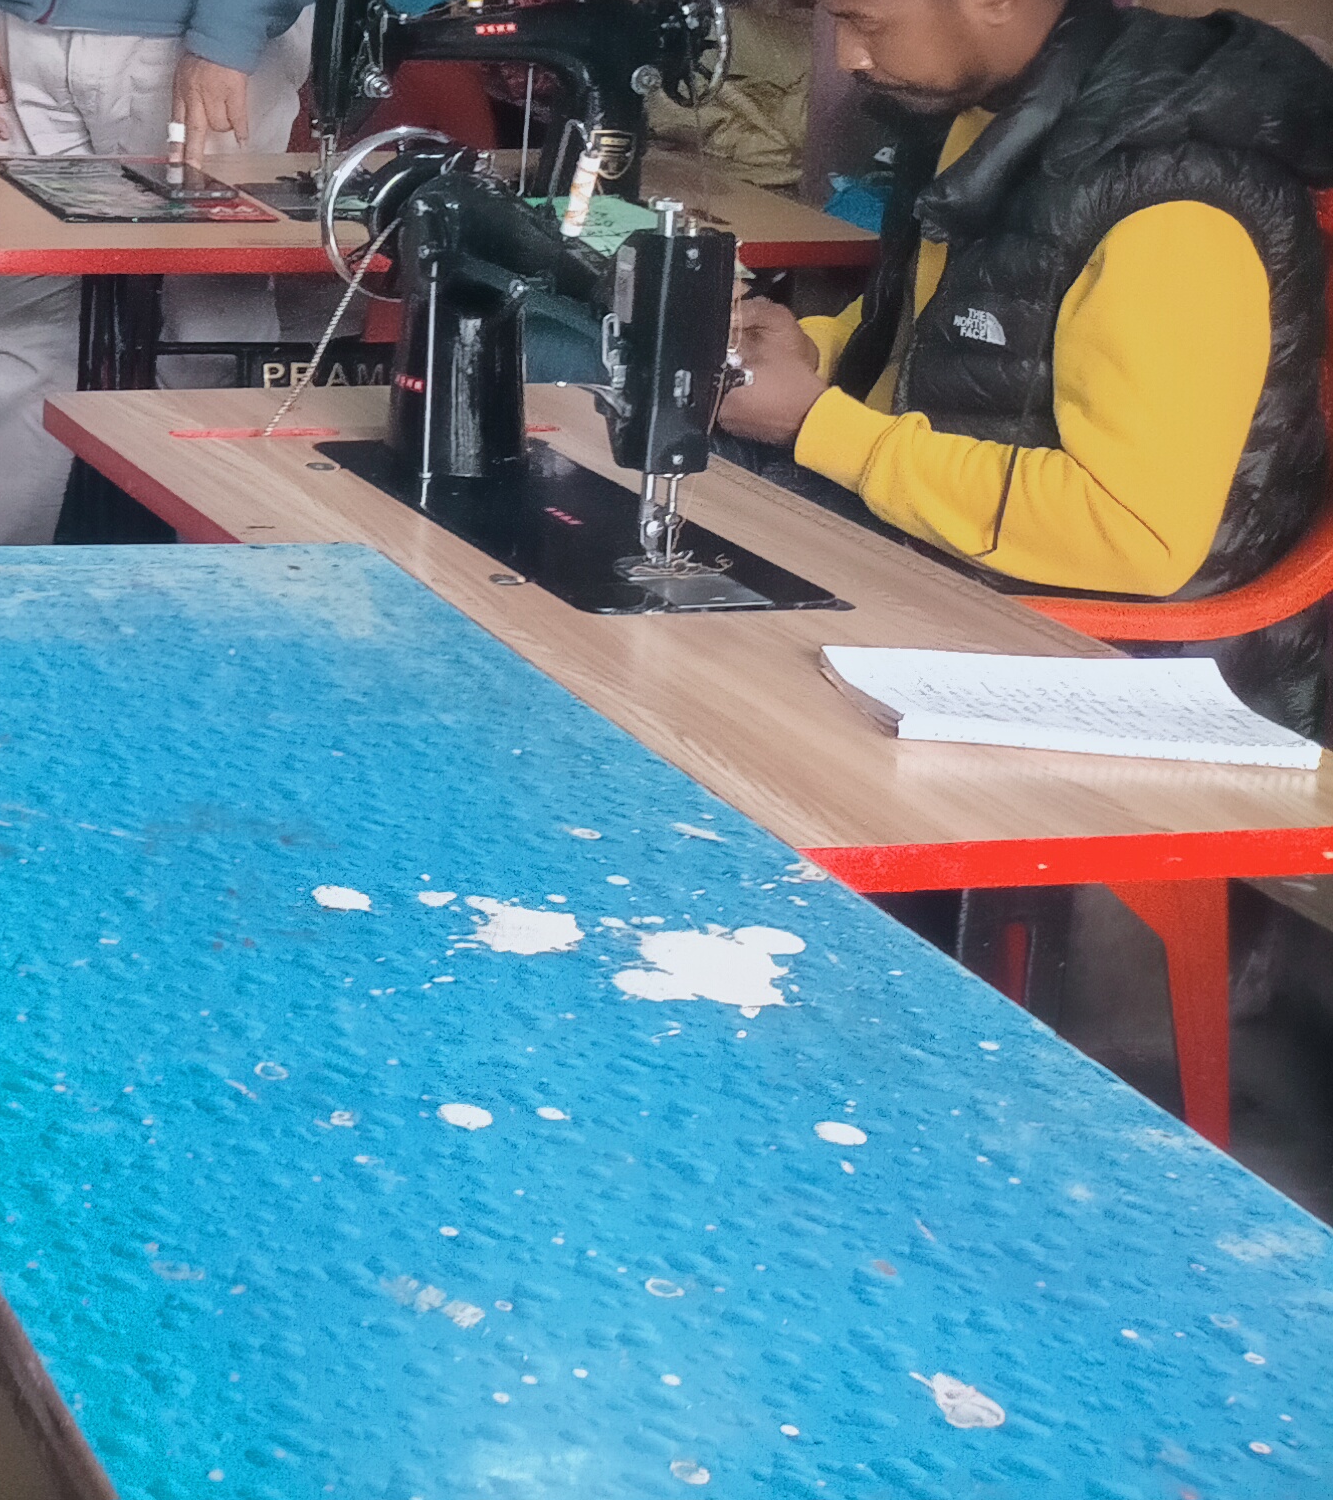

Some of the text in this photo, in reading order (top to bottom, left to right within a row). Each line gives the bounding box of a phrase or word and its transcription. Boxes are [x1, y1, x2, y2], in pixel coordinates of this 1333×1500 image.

[967, 307, 987, 321] THE
[953, 314, 988, 331] NORTH
[959, 326, 988, 342] FACE
